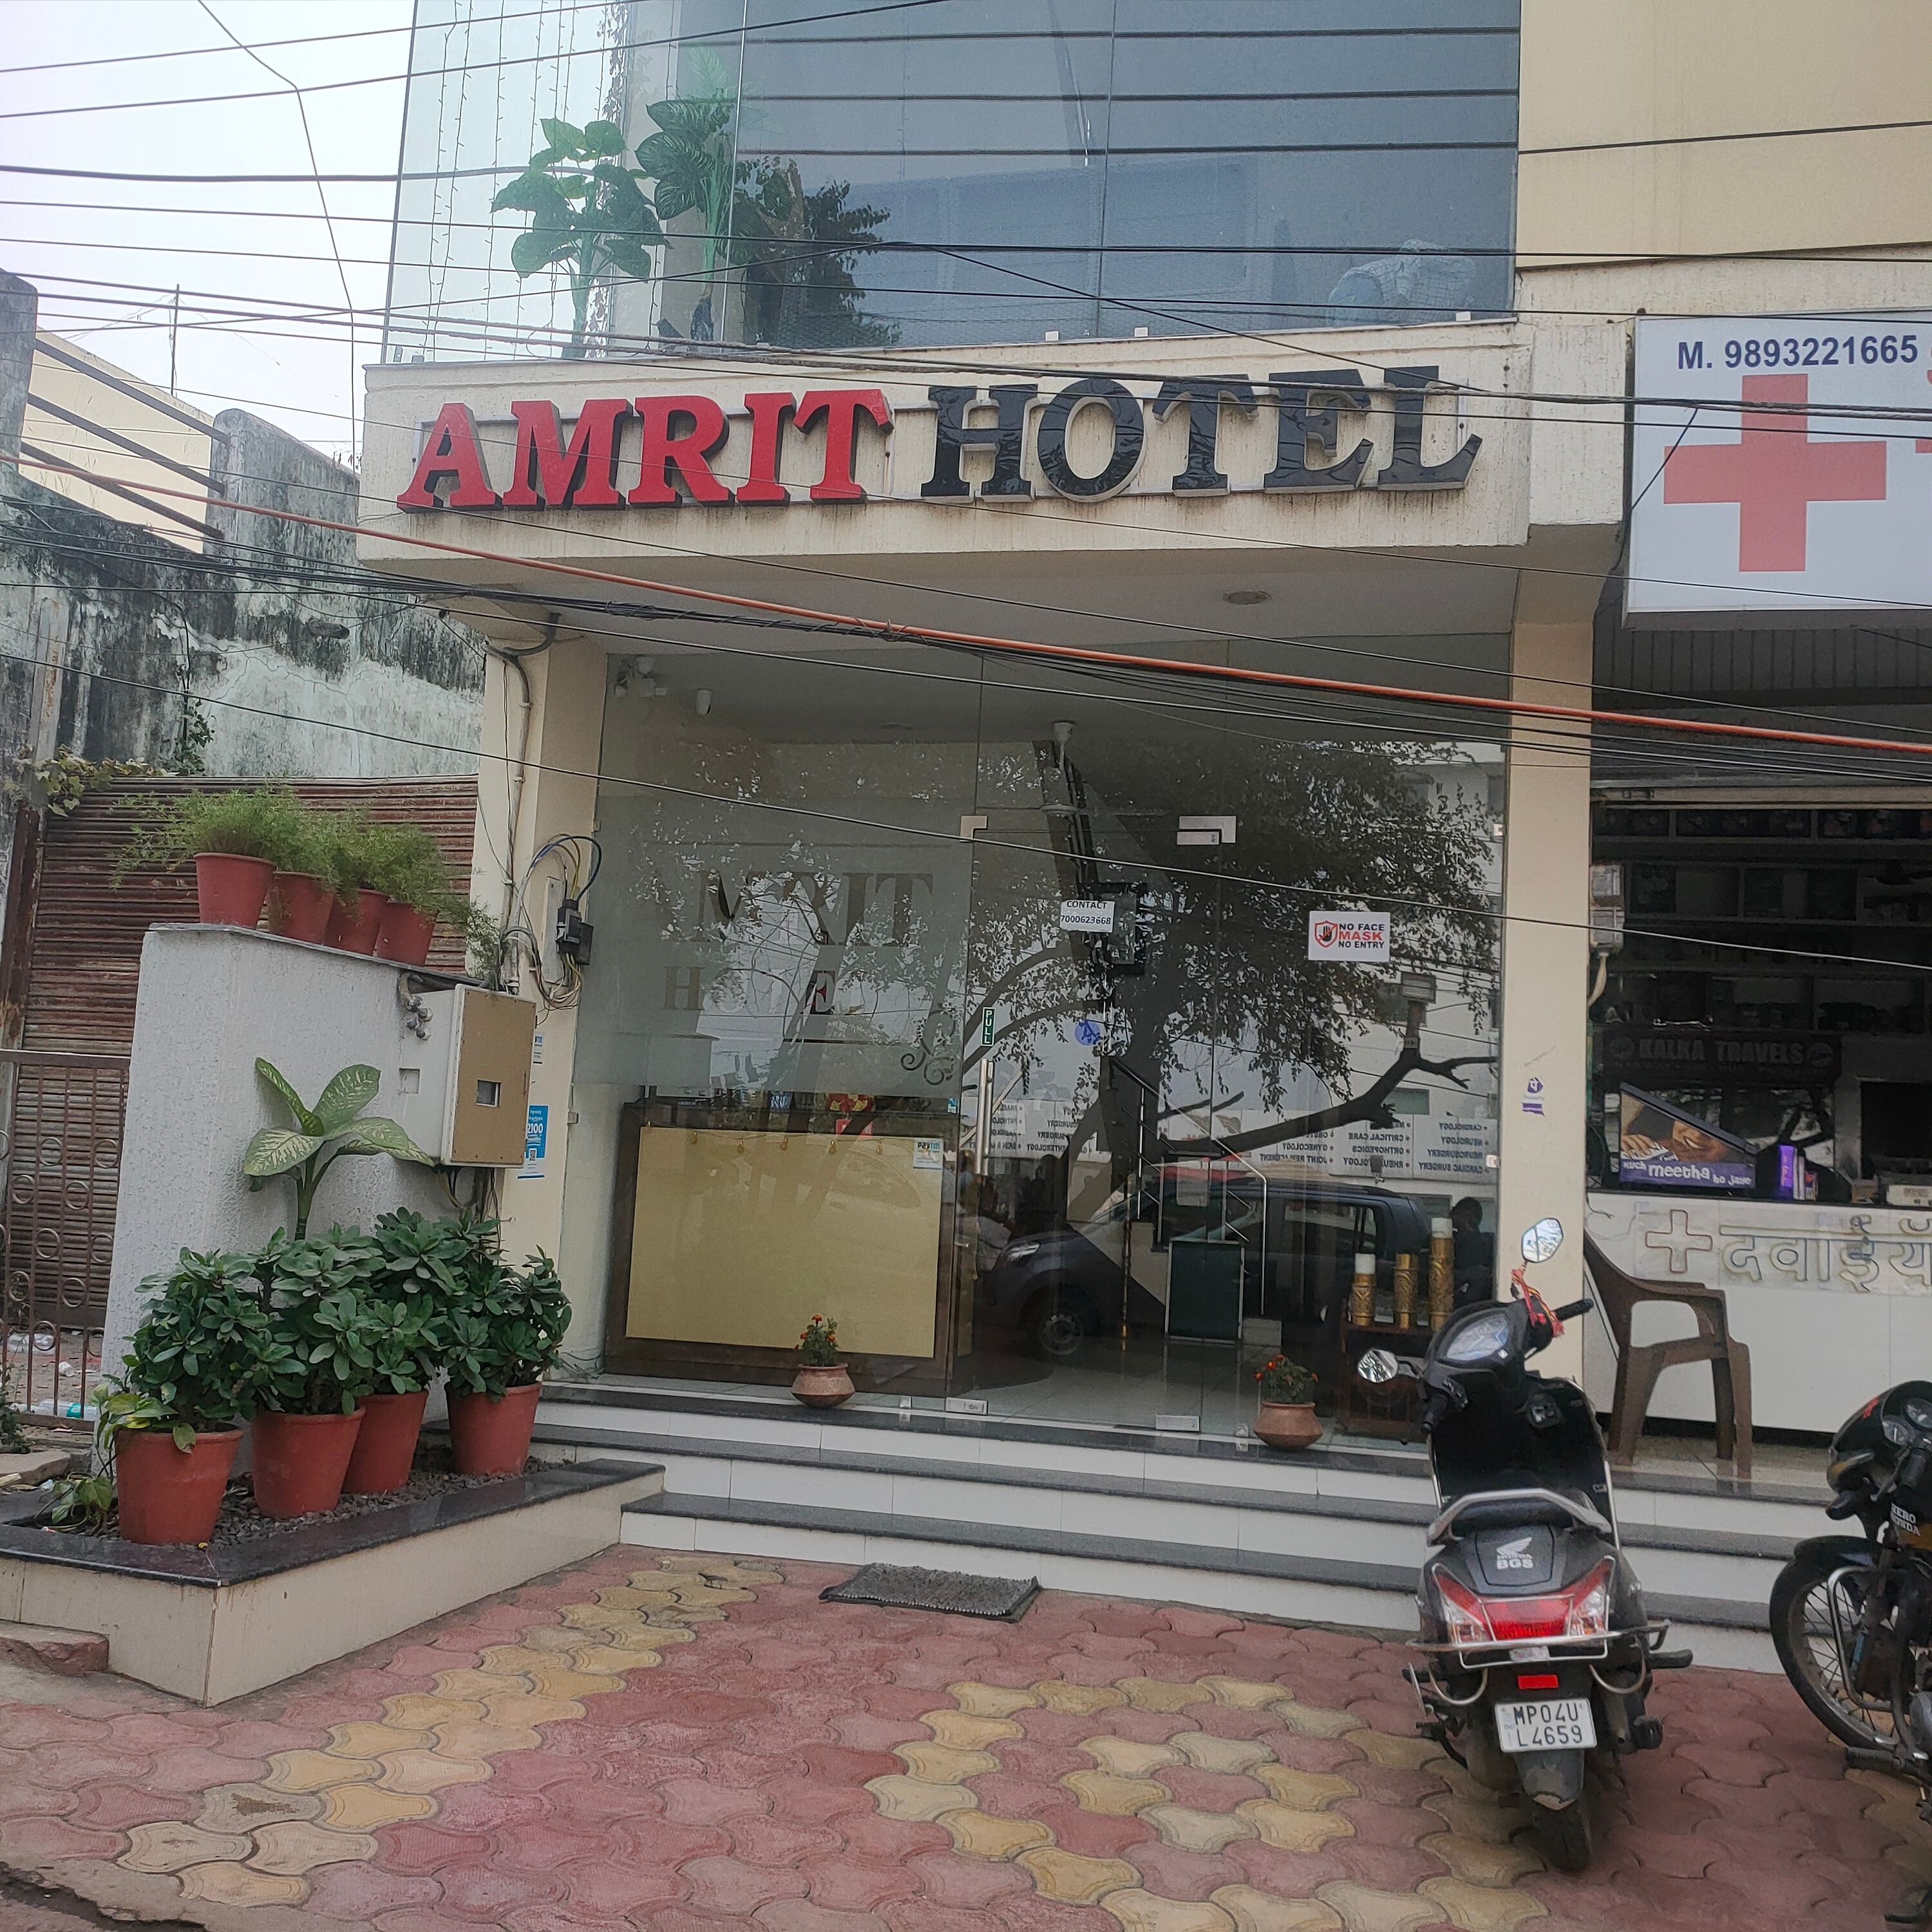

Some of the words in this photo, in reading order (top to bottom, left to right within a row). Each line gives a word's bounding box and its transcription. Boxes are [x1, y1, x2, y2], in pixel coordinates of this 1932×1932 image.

[1678, 341, 1712, 369] M.
[1725, 335, 1918, 368] 9893221665
[397, 388, 894, 513] AMRIT
[921, 365, 1482, 502] HOTEL
[1061, 915, 1111, 924] 7000623668
[1339, 931, 1383, 940] MASK
[984, 1010, 992, 1043] PULL
[1891, 1502, 1917, 1524] HERO
[1497, 1558, 1534, 1570] BGS
[1513, 1703, 1578, 1725] MP04U
[1517, 1725, 1582, 1747] L4659
